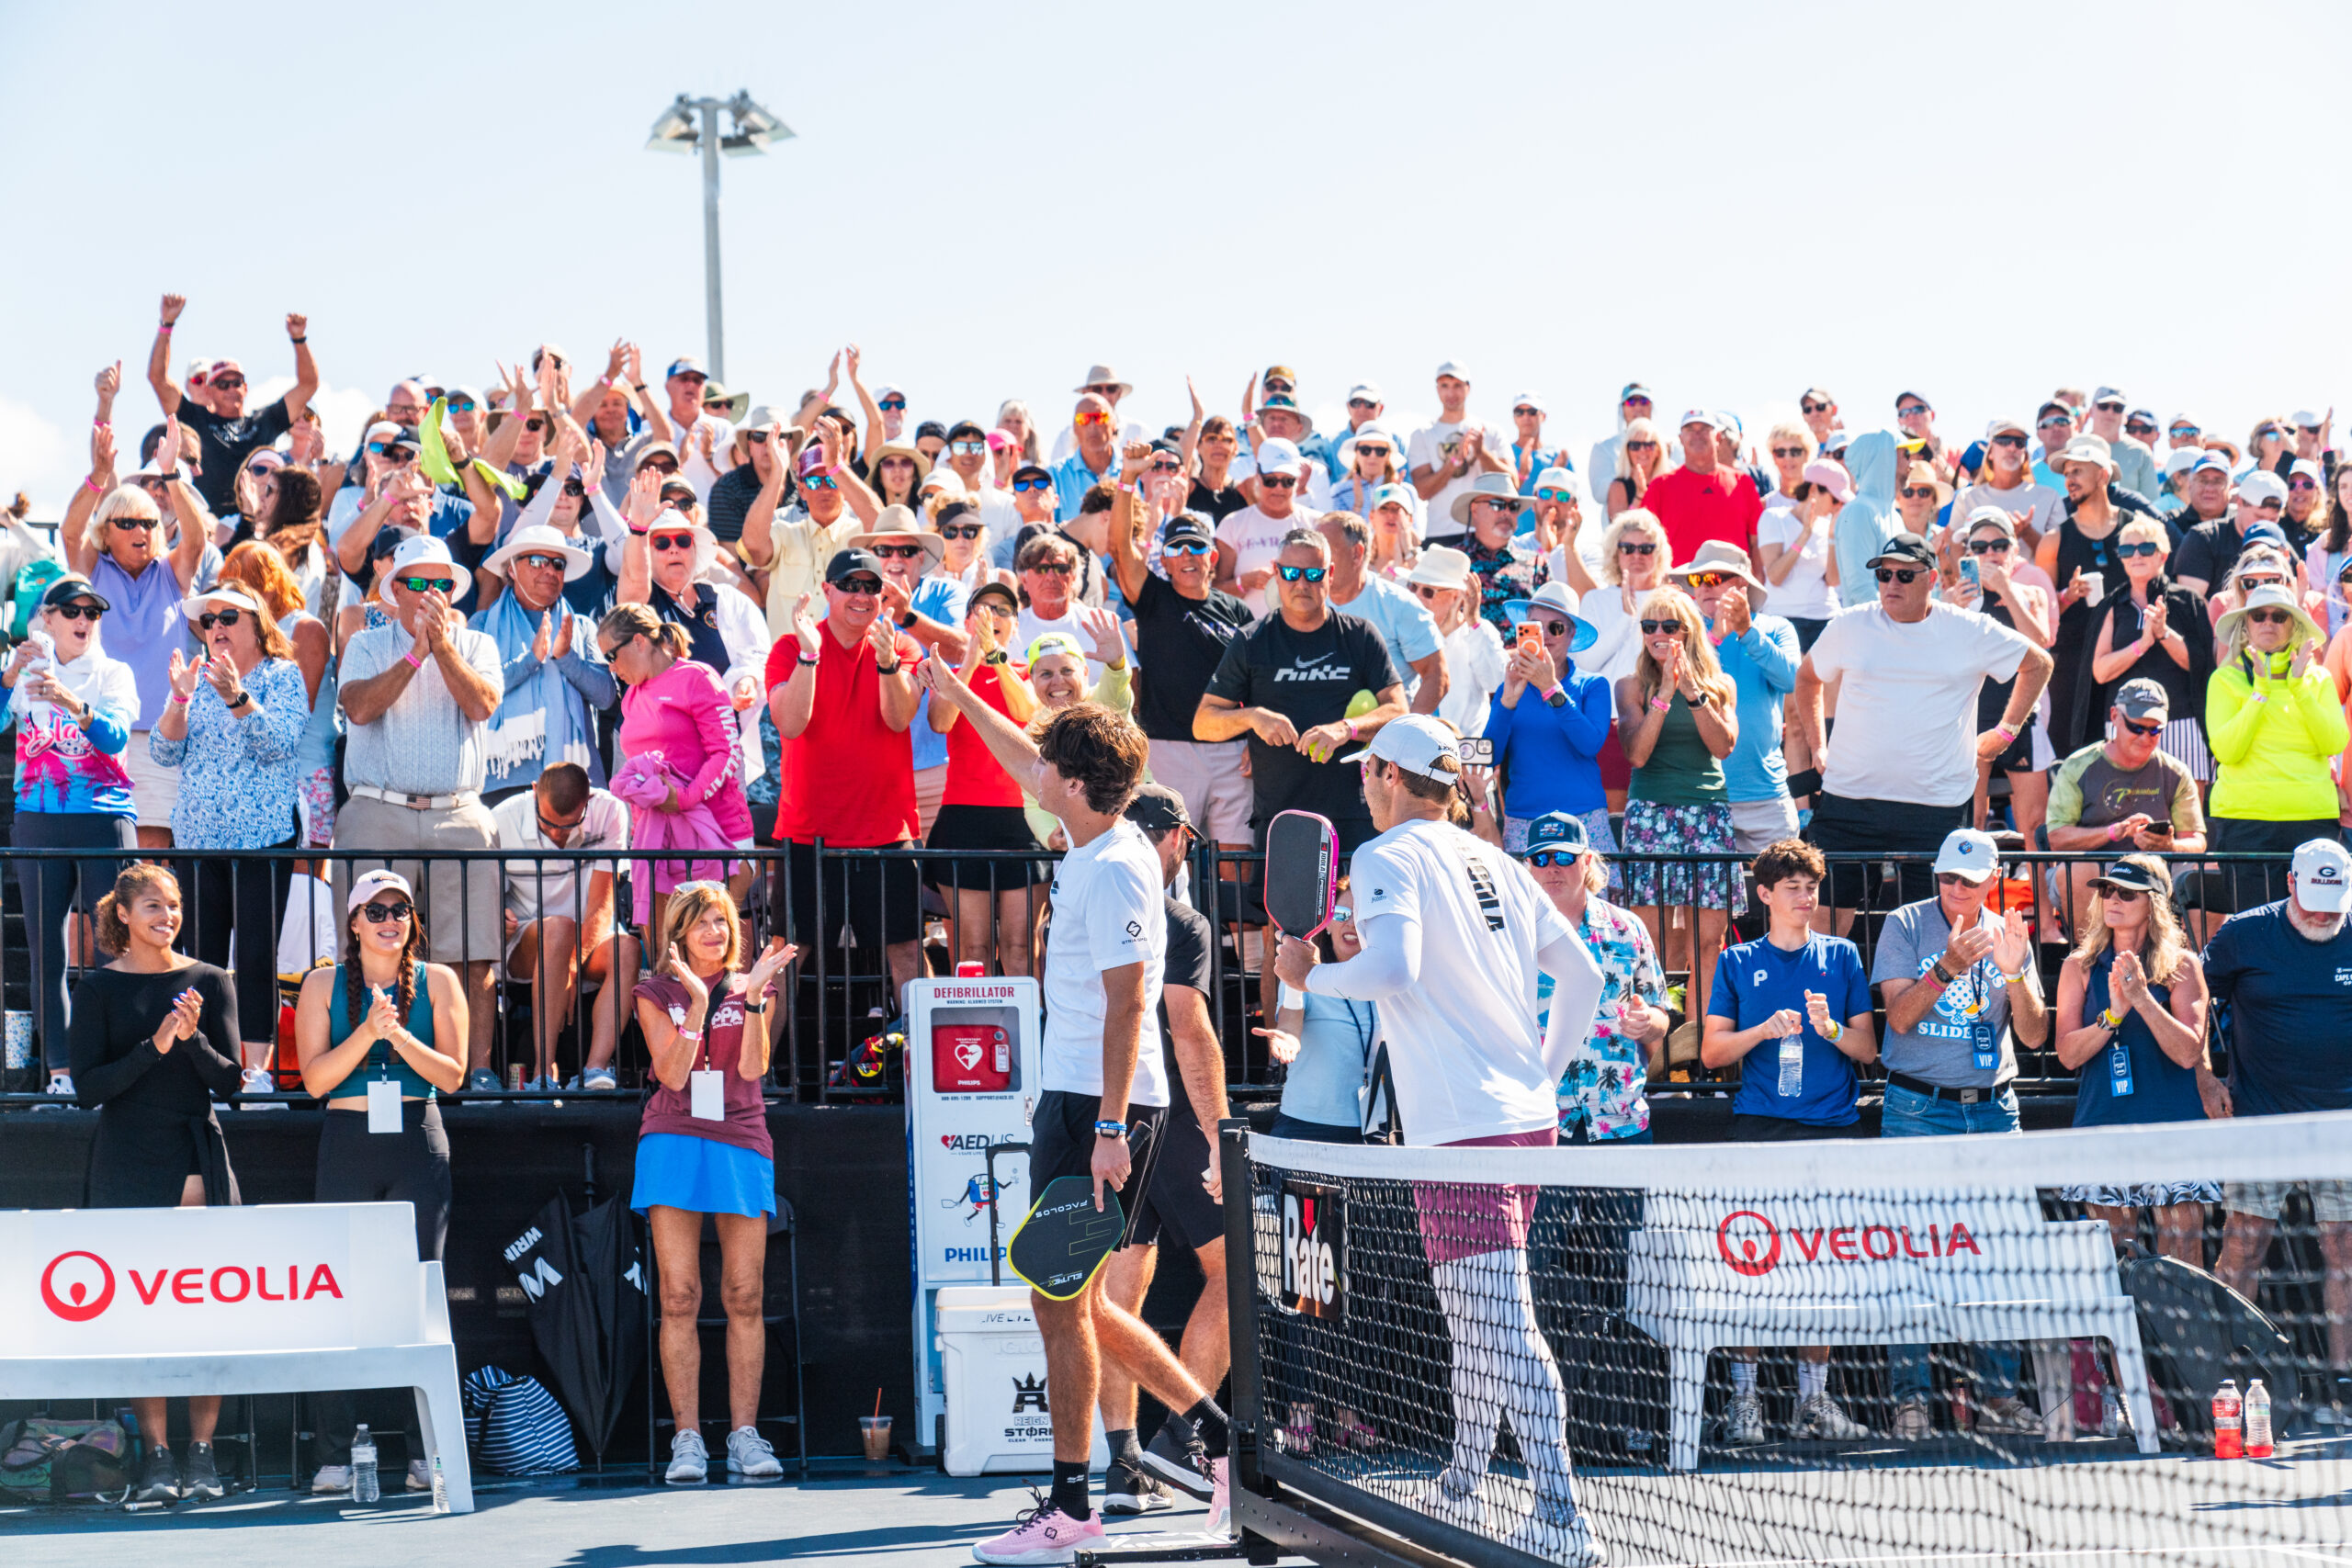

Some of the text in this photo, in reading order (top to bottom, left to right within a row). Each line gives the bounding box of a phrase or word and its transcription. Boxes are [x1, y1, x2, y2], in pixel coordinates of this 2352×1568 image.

[1753, 969, 1768, 987] P
[1918, 950, 2007, 988] COLUS
[933, 987, 1014, 998] DEFIBRILLATOR
[711, 1006, 743, 1026] PPA
[1918, 1021, 1972, 1039] SLIDE
[1978, 1055, 1993, 1066] VIP
[2116, 1080, 2128, 1093] VIP
[1035, 1200, 1088, 1218] FACOLOS
[1284, 1193, 1334, 1305] Rate
[1791, 1223, 1982, 1261] VEOLIA
[944, 1247, 1007, 1262] PHILP
[127, 1264, 344, 1305] VEOLIA
[1014, 1416, 1048, 1426] REIGN
